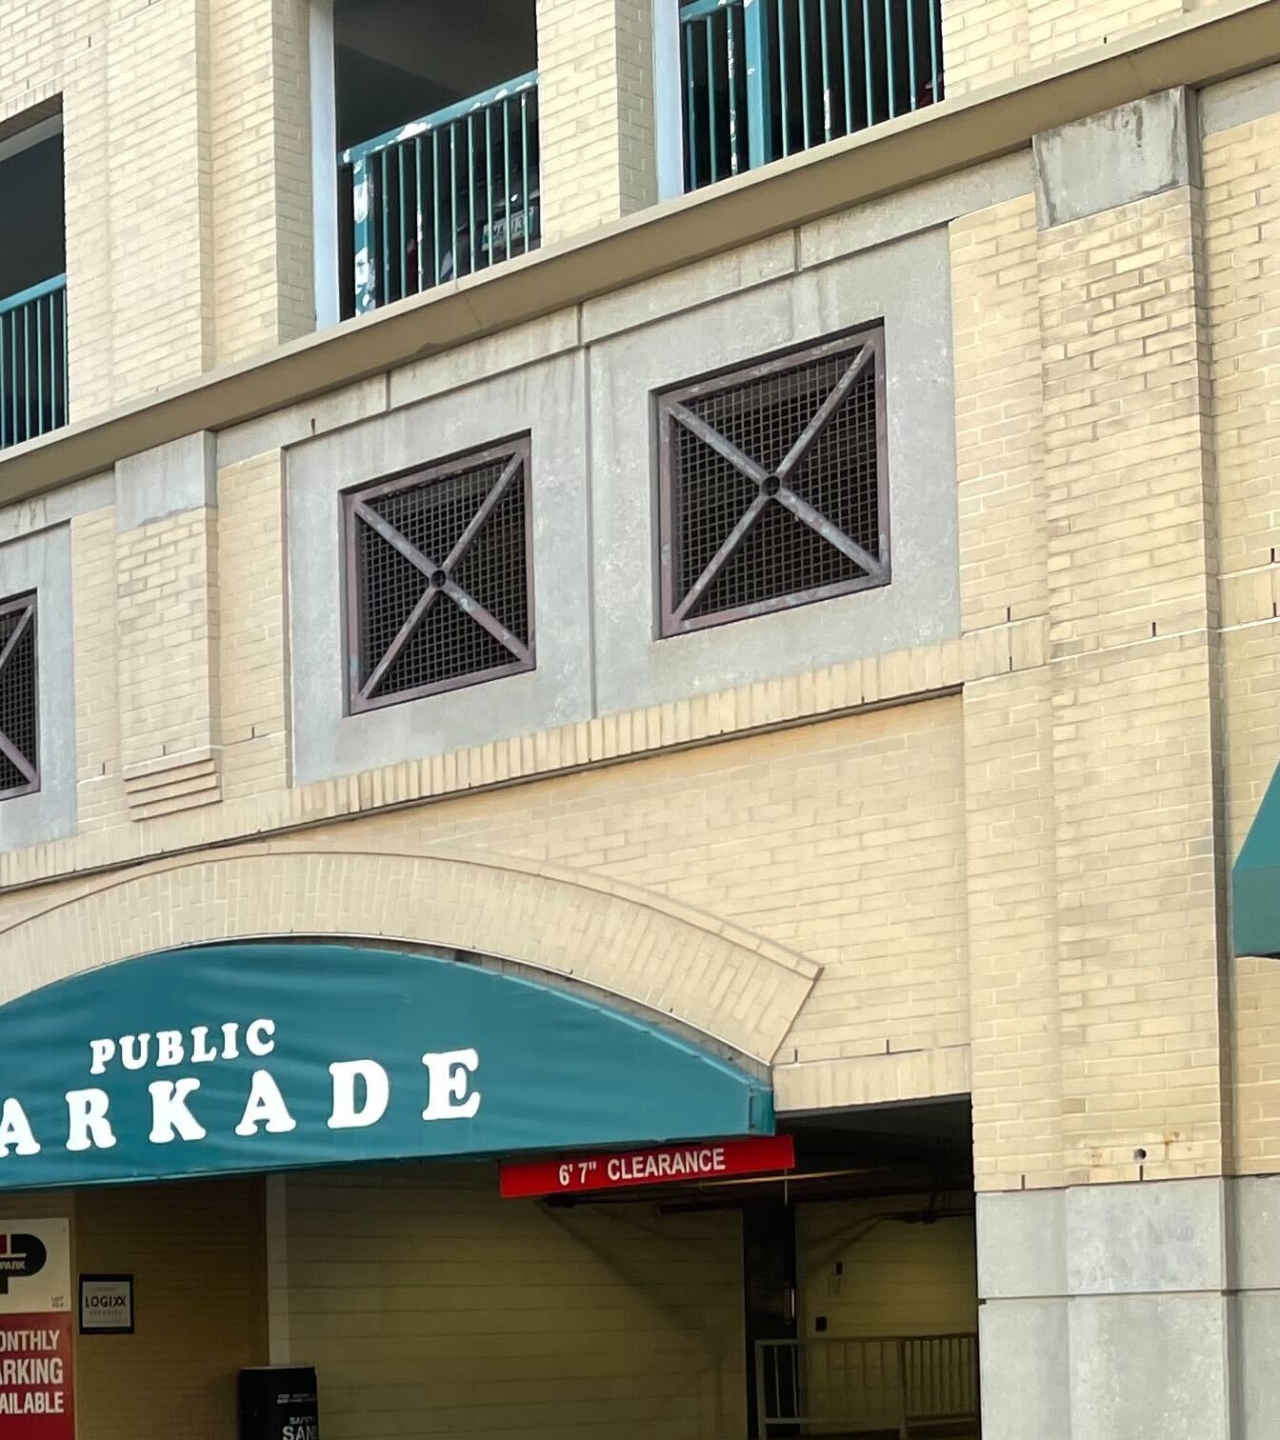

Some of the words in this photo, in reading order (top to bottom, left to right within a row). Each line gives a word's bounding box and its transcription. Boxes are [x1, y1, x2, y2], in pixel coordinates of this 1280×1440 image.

[90, 1019, 276, 1074] PUBLIC
[607, 1148, 726, 1181] CLEARANCE
[85, 1295, 127, 1308] LOGIXX
